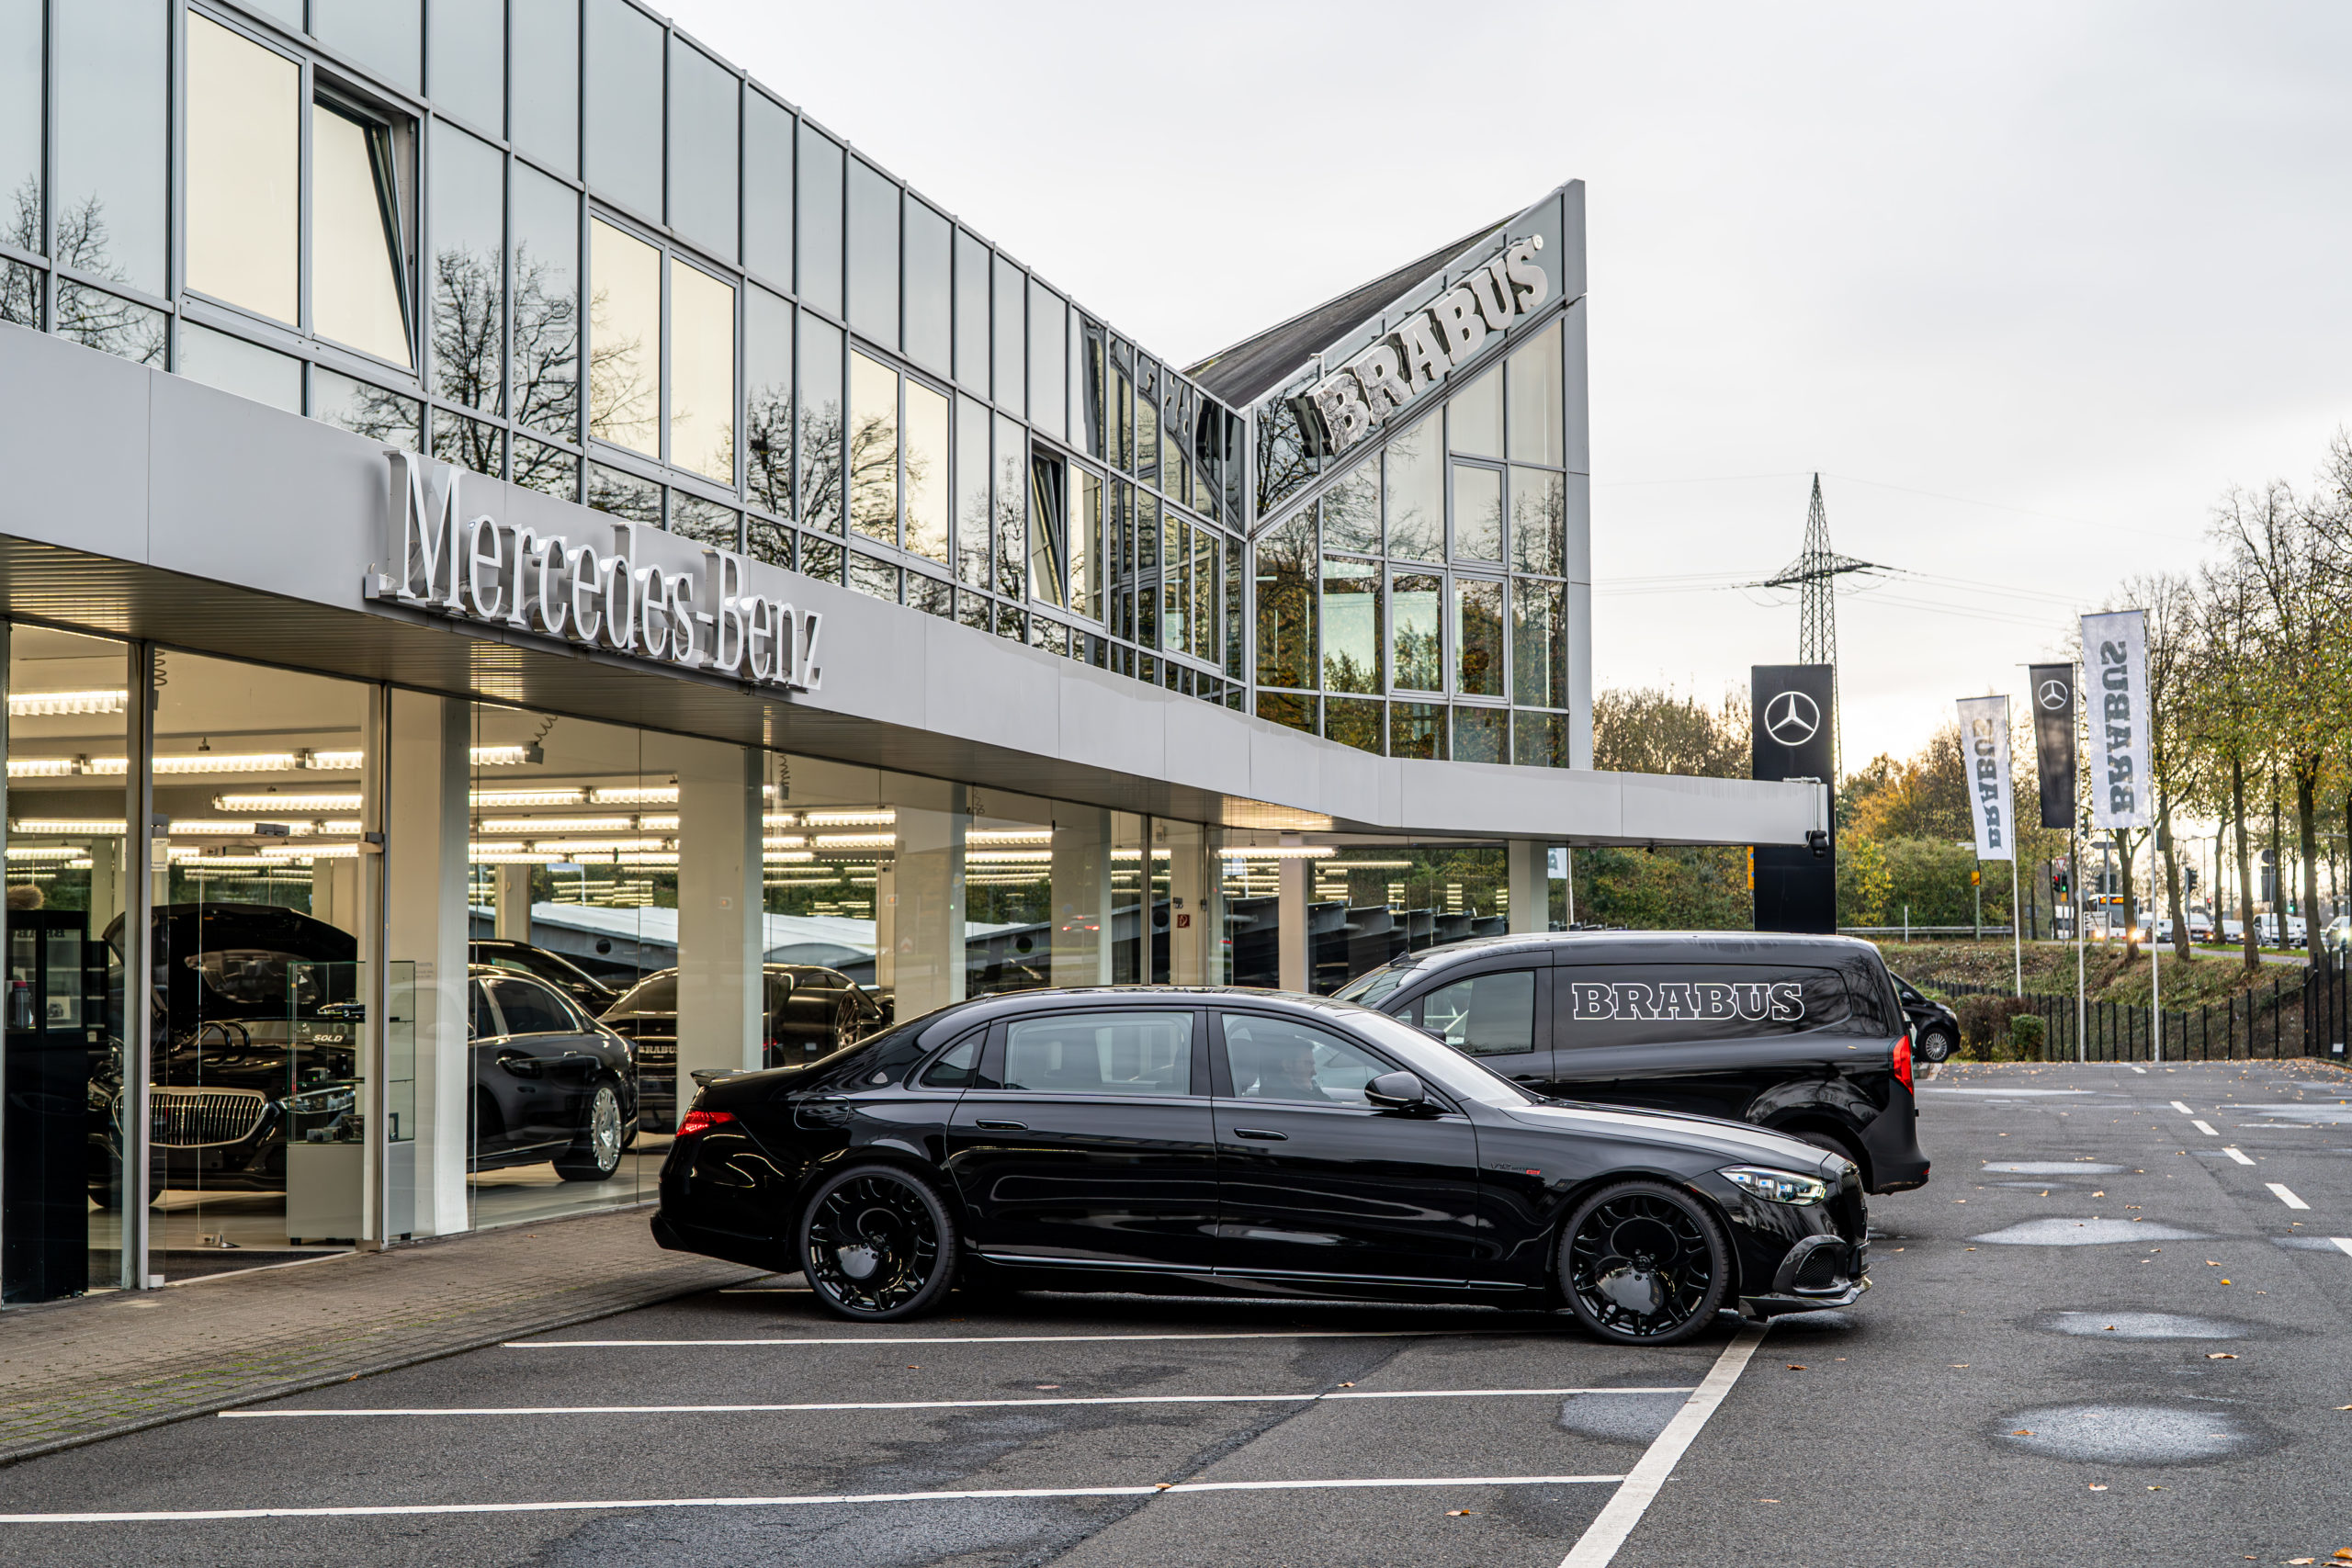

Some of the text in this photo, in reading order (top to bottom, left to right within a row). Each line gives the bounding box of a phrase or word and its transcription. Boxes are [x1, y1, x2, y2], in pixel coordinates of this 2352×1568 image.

[1311, 236, 1549, 456] BRABUS
[393, 450, 824, 692] Mercedes-Benz
[313, 1033, 344, 1043] SOLD
[1572, 983, 1804, 1021] BRABUS
